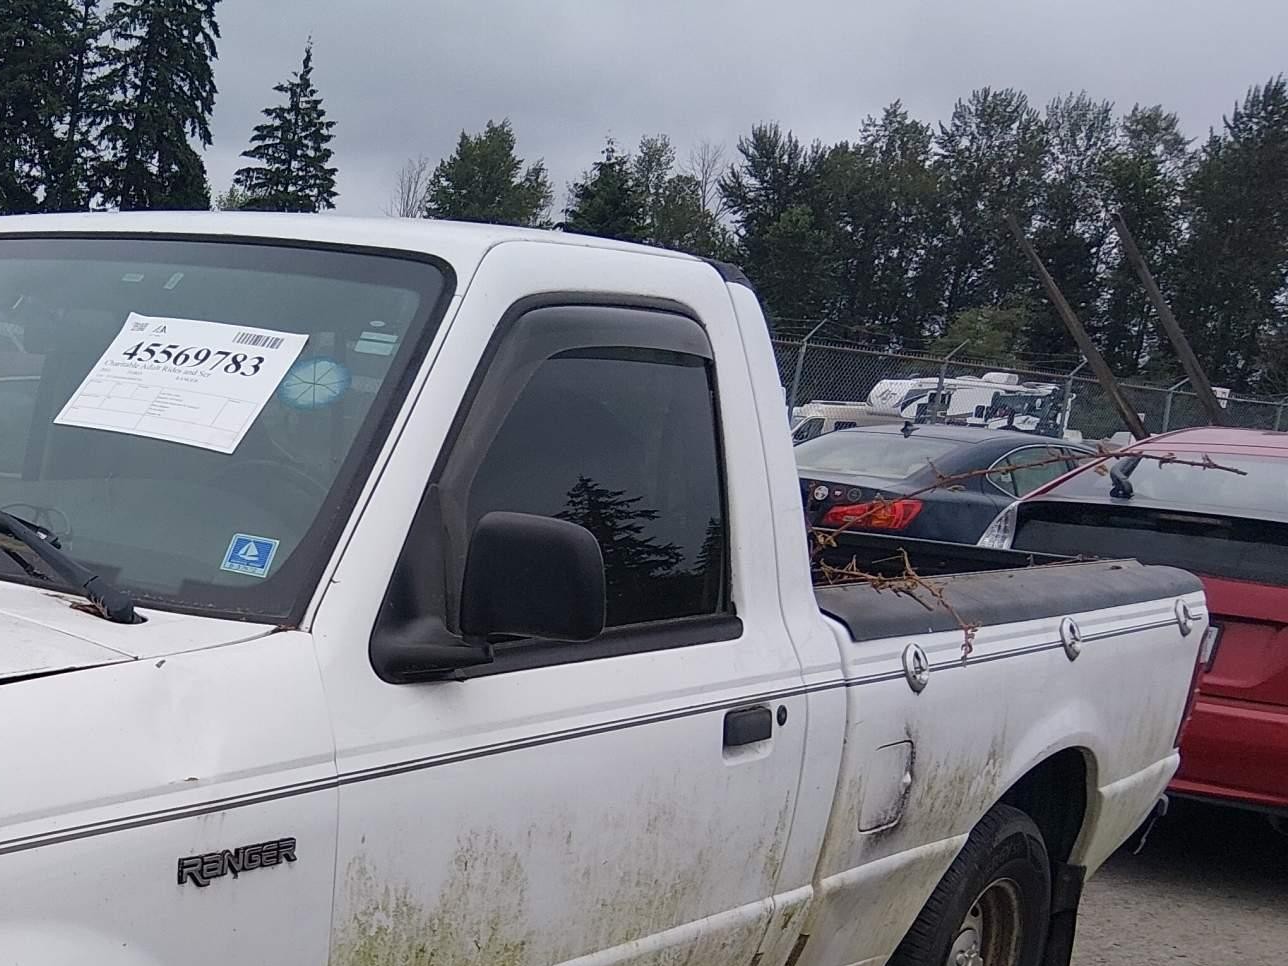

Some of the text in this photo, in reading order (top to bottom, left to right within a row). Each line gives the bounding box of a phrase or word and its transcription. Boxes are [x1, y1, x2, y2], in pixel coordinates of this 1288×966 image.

[122, 340, 265, 377] 45569783
[161, 365, 182, 374] Rides
[182, 368, 199, 376] and
[177, 837, 297, 887] RANGER
